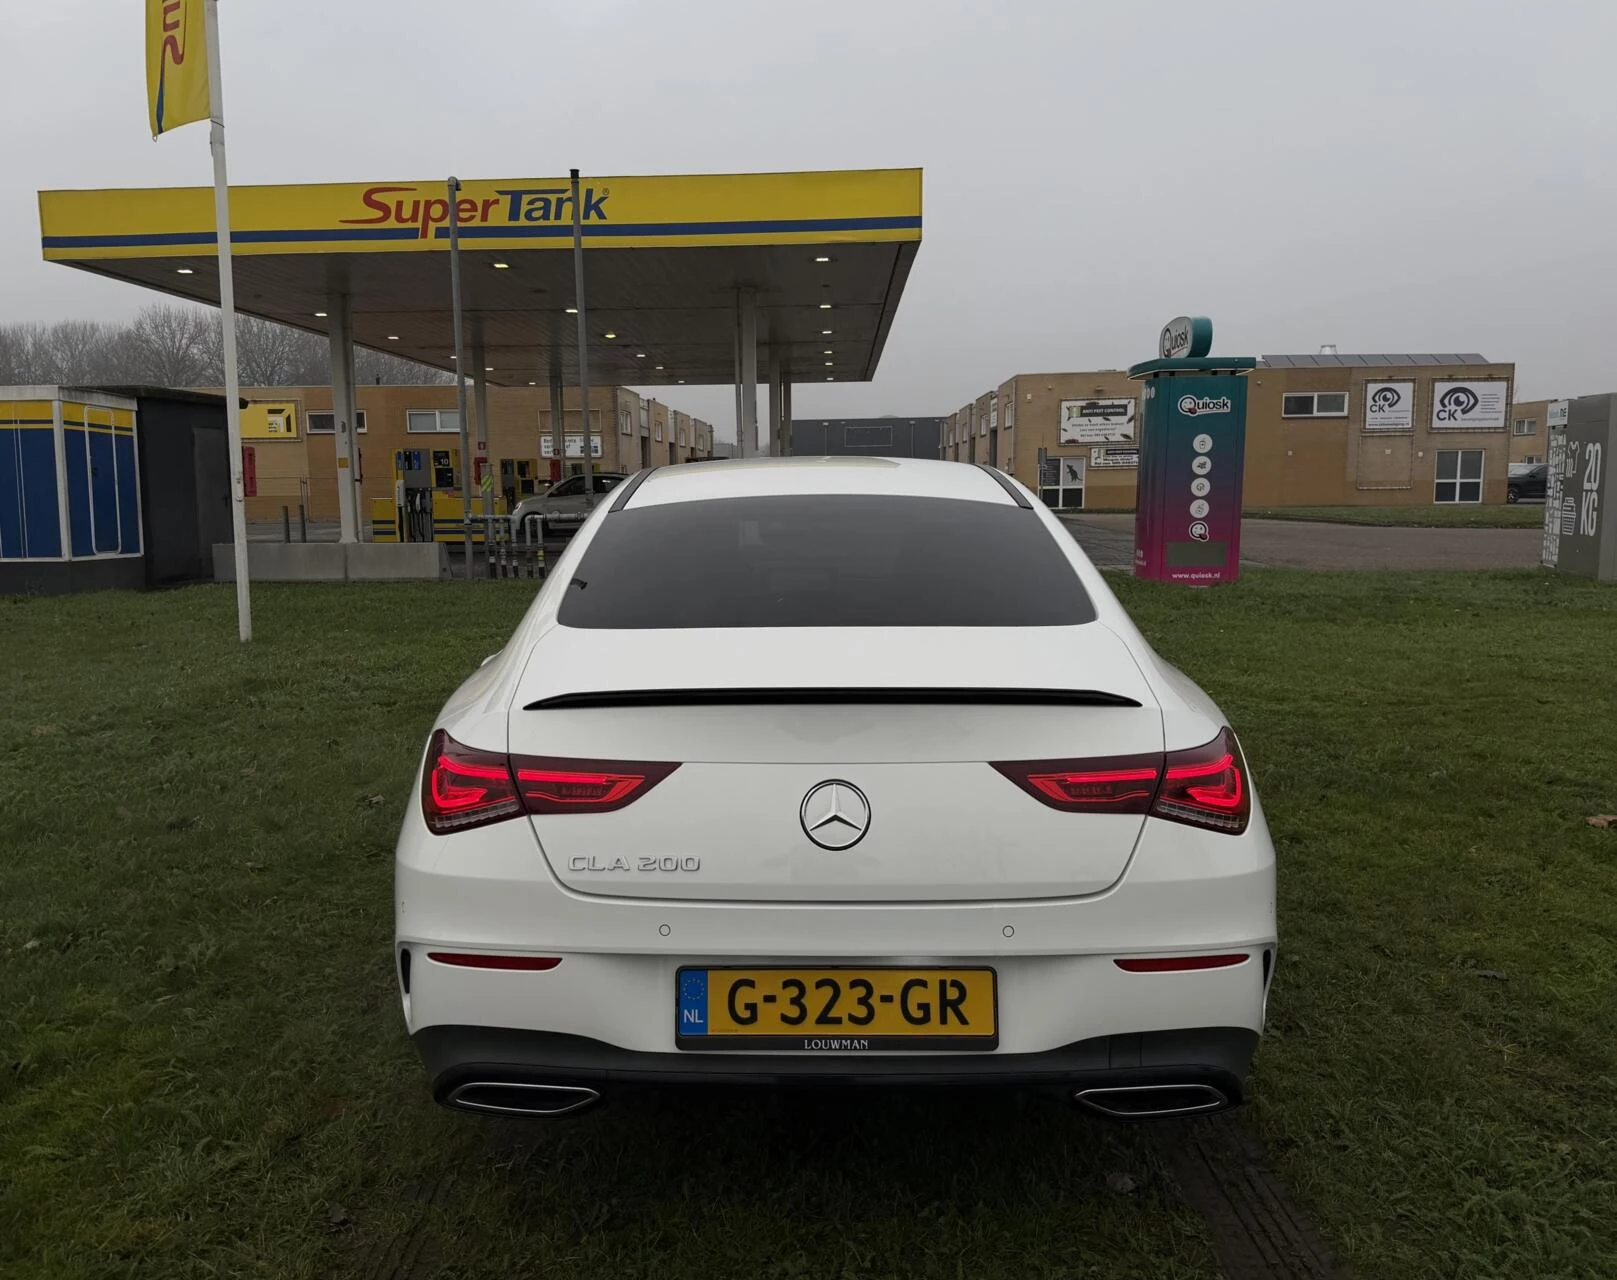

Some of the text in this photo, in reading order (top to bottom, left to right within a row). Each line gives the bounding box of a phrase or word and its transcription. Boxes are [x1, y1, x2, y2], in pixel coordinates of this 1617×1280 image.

[1162, 327, 1189, 358] Quiosk
[1179, 396, 1230, 415] Quiosk
[1369, 404, 1386, 413] CK
[1436, 409, 1459, 421] CK
[1583, 442, 1602, 491] 20
[1580, 491, 1598, 537] KG
[568, 855, 701, 872] CLA 200
[727, 978, 970, 1026] G-323-GR
[683, 1008, 704, 1023] NL
[804, 1039, 869, 1050] LOUWMAN
